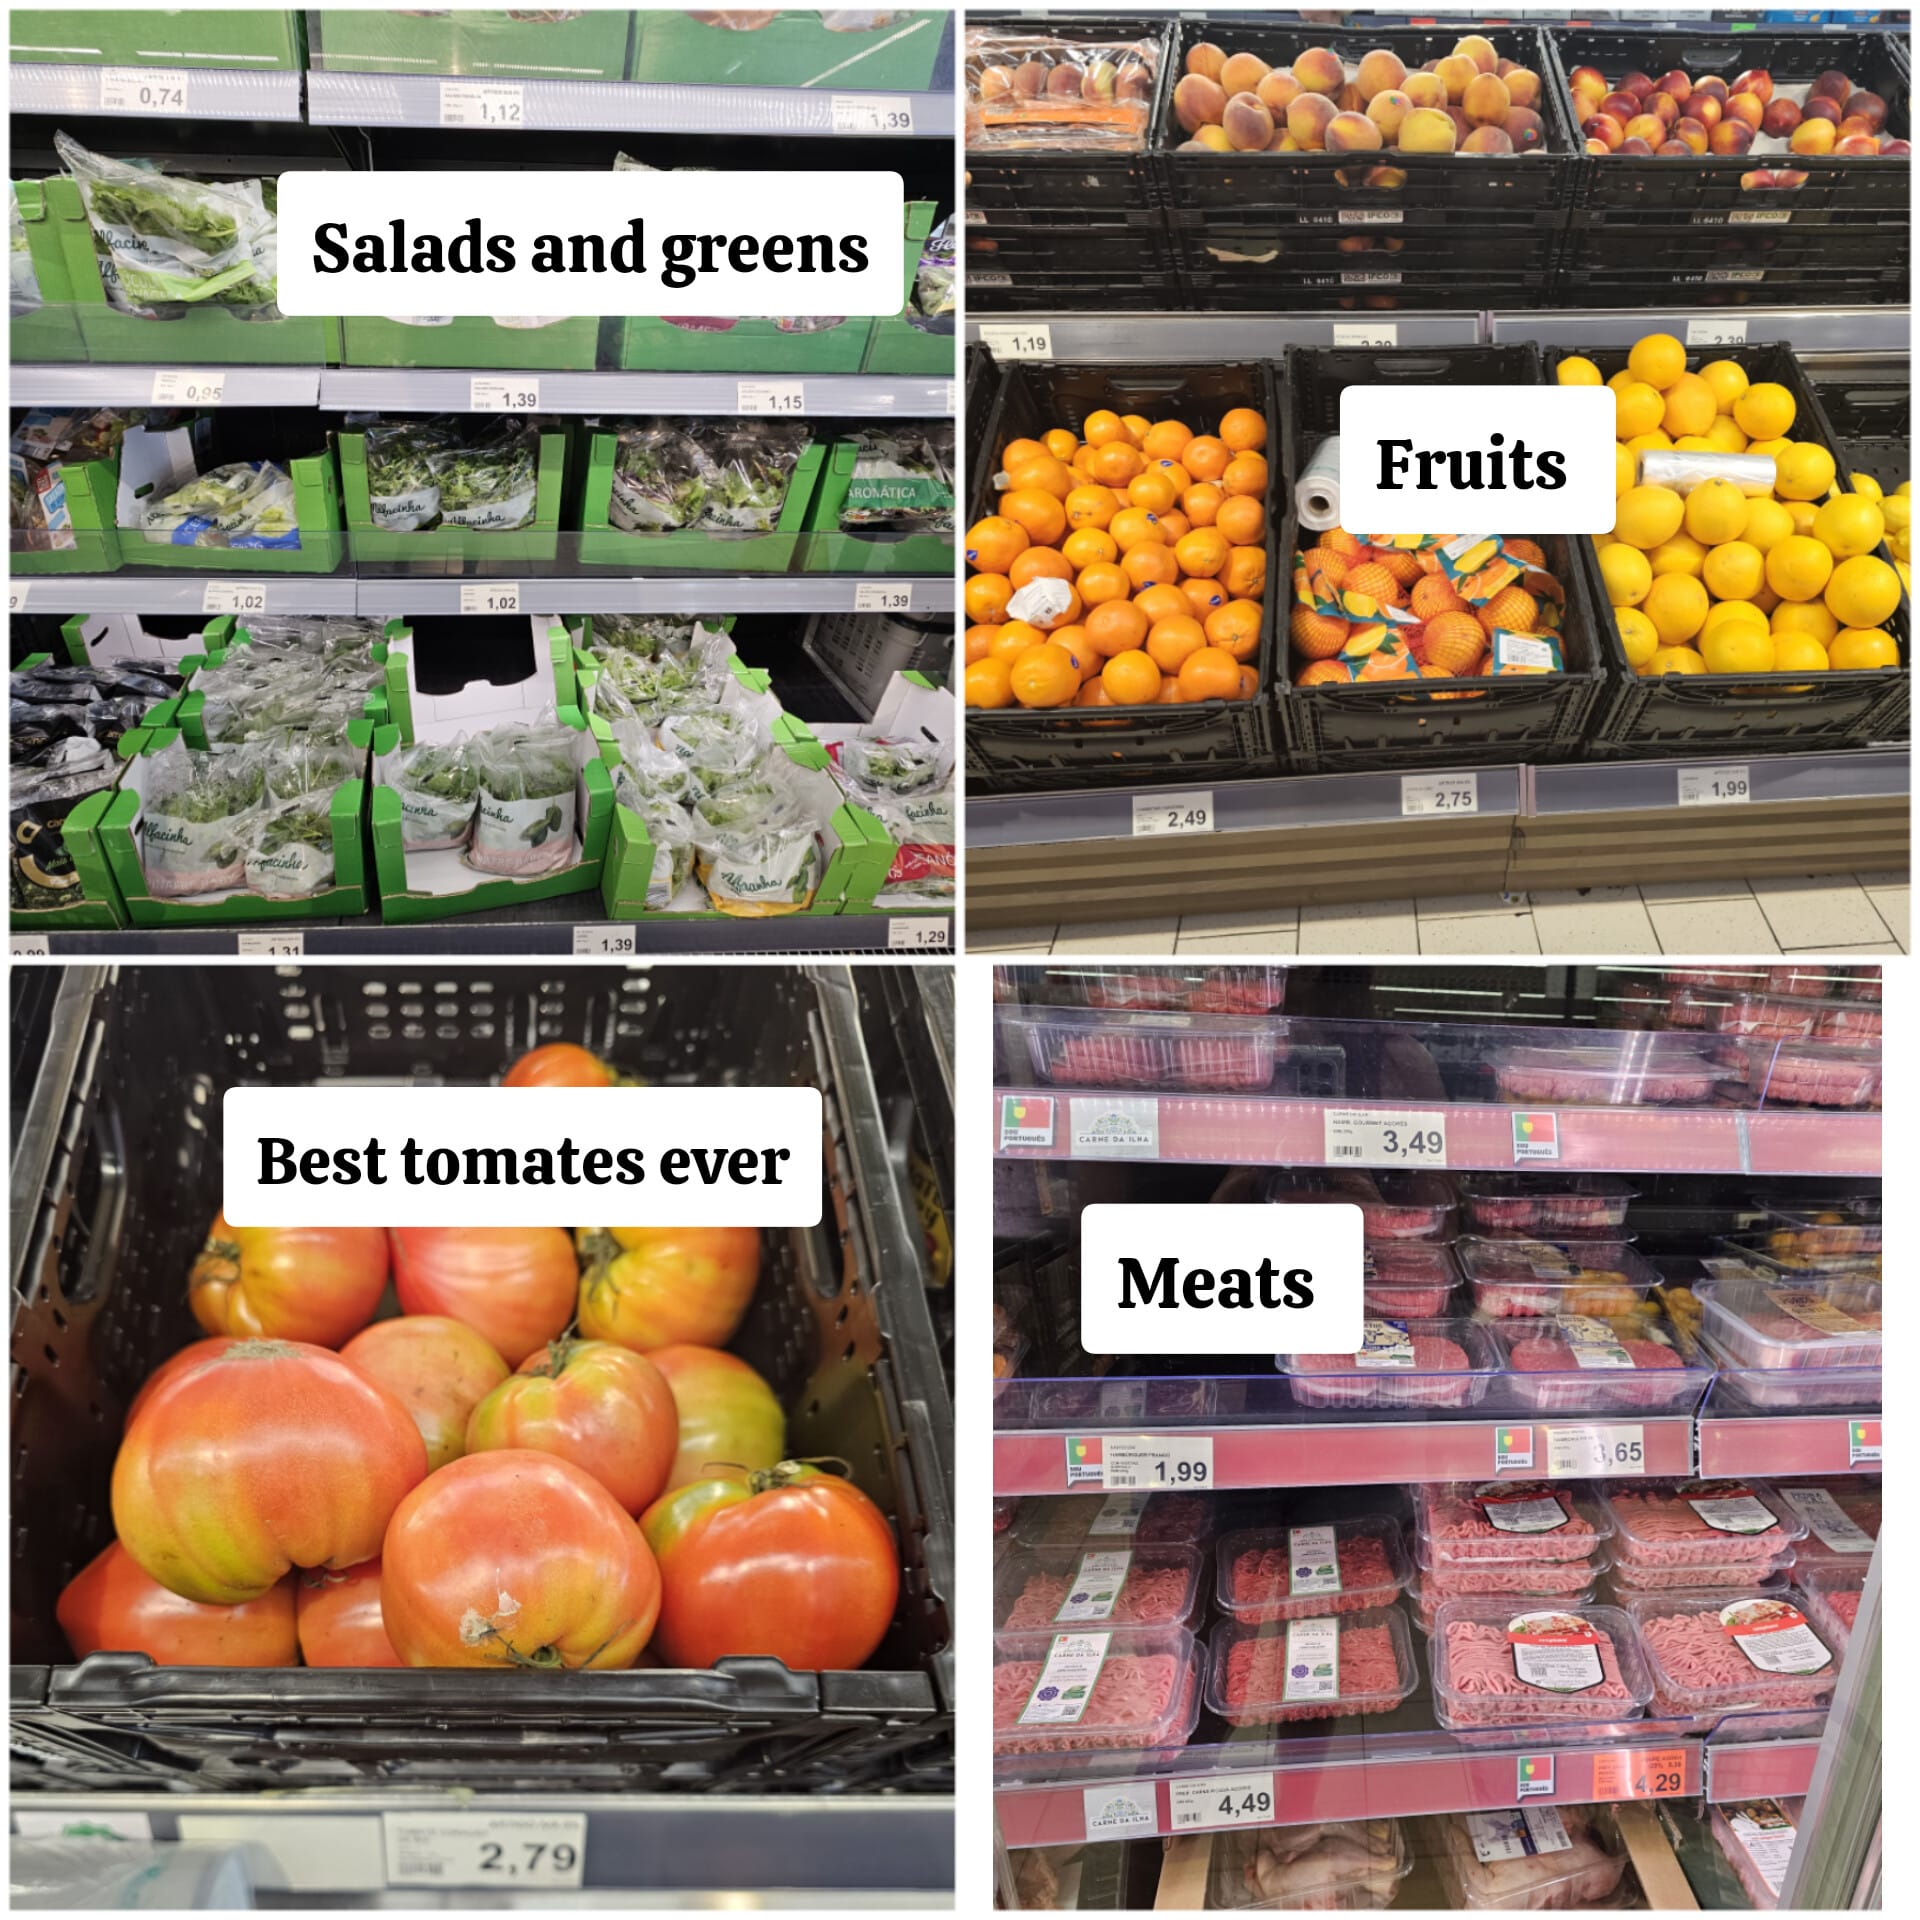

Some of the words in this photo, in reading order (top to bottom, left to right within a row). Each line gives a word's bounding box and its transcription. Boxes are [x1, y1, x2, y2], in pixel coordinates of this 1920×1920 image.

[140, 87, 184, 107] 0,74
[480, 102, 520, 123] 1,12
[870, 111, 911, 130] 1,39
[1012, 336, 1047, 353] 1,19
[186, 385, 223, 402] 0,95
[502, 392, 537, 408] 1,39
[768, 395, 803, 411] 1,15
[232, 595, 263, 610] 1,02
[487, 597, 516, 611] 1,02
[881, 594, 909, 608] 1,39
[1711, 780, 1748, 799] 1,99
[1435, 791, 1473, 810] 2,75
[1167, 809, 1207, 829] 2,49
[601, 938, 633, 953] 1,39
[915, 930, 945, 945] 1,29
[1383, 1129, 1443, 1158] 3,49
[1593, 1441, 1643, 1467] 3,65
[1155, 1460, 1207, 1486] 1,99
[1635, 1772, 1682, 1796] 4,29
[1218, 1791, 1272, 1818] 4,49
[1091, 1819, 1118, 1827] CARNE
[478, 1842, 577, 1876] 2,79
